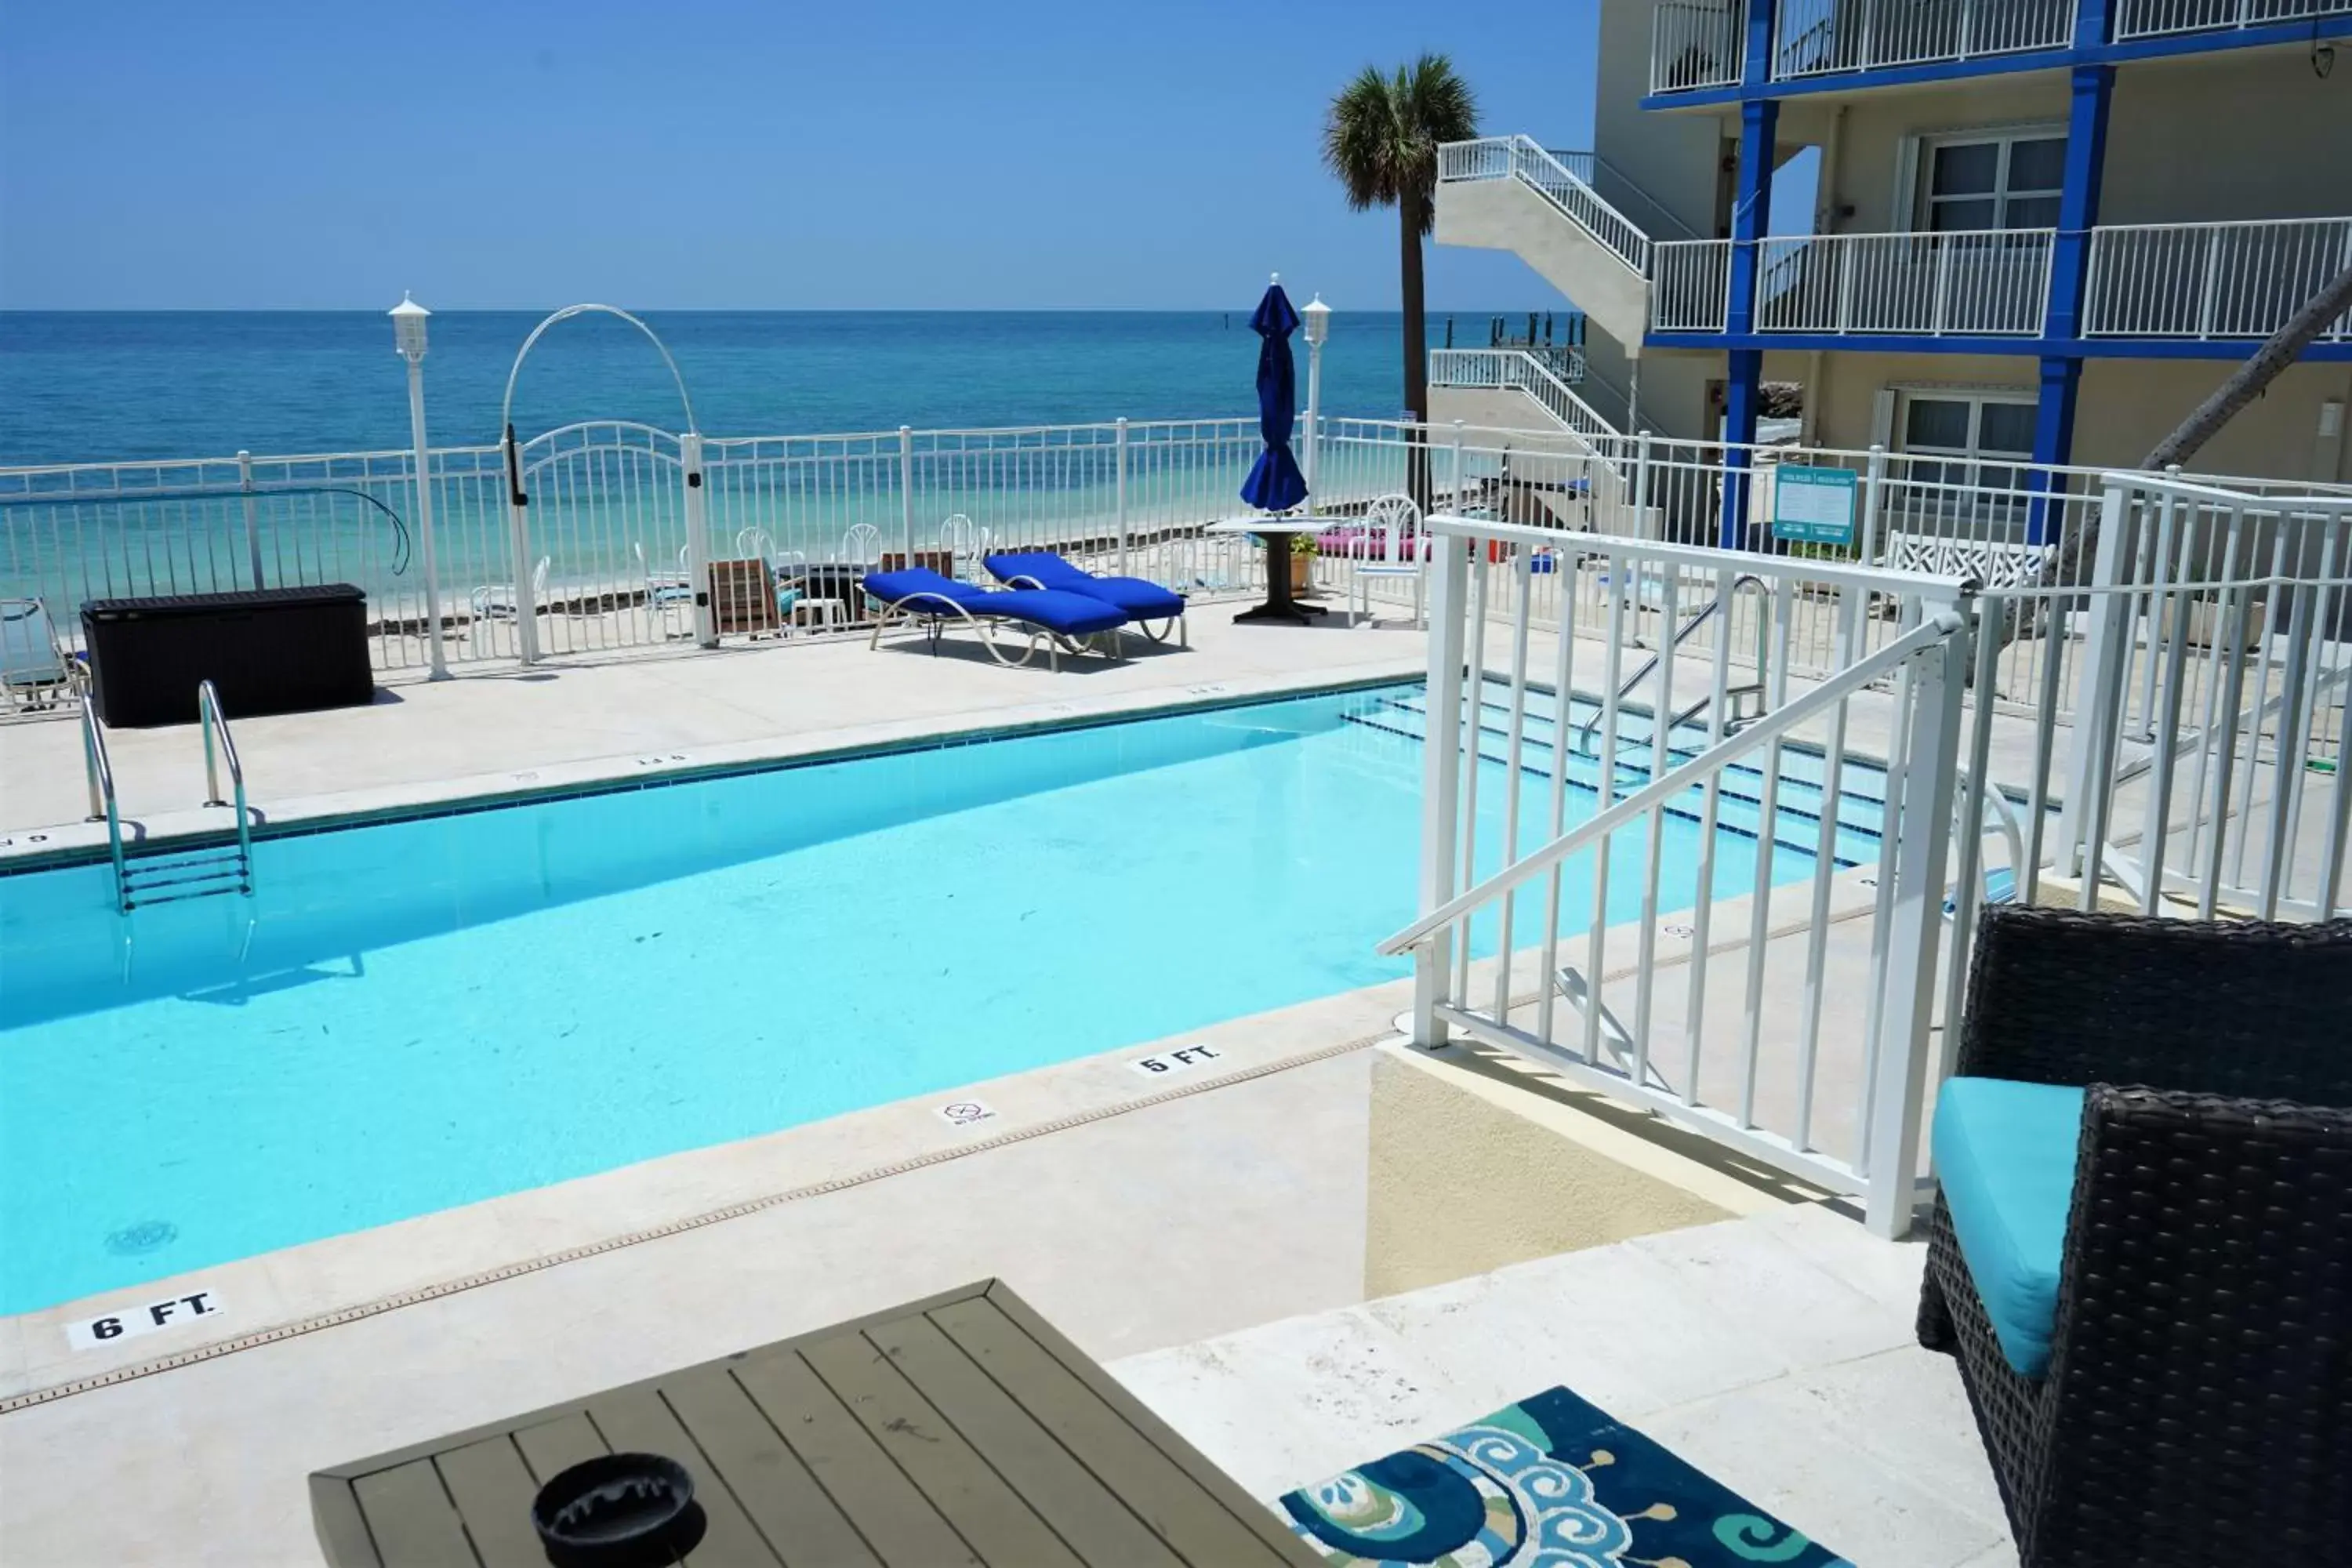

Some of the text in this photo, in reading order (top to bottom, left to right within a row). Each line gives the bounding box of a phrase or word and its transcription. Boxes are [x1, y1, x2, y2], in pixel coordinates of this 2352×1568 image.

[1140, 1046, 1221, 1072] 5 FT.
[92, 1292, 216, 1339] 6 FT.
